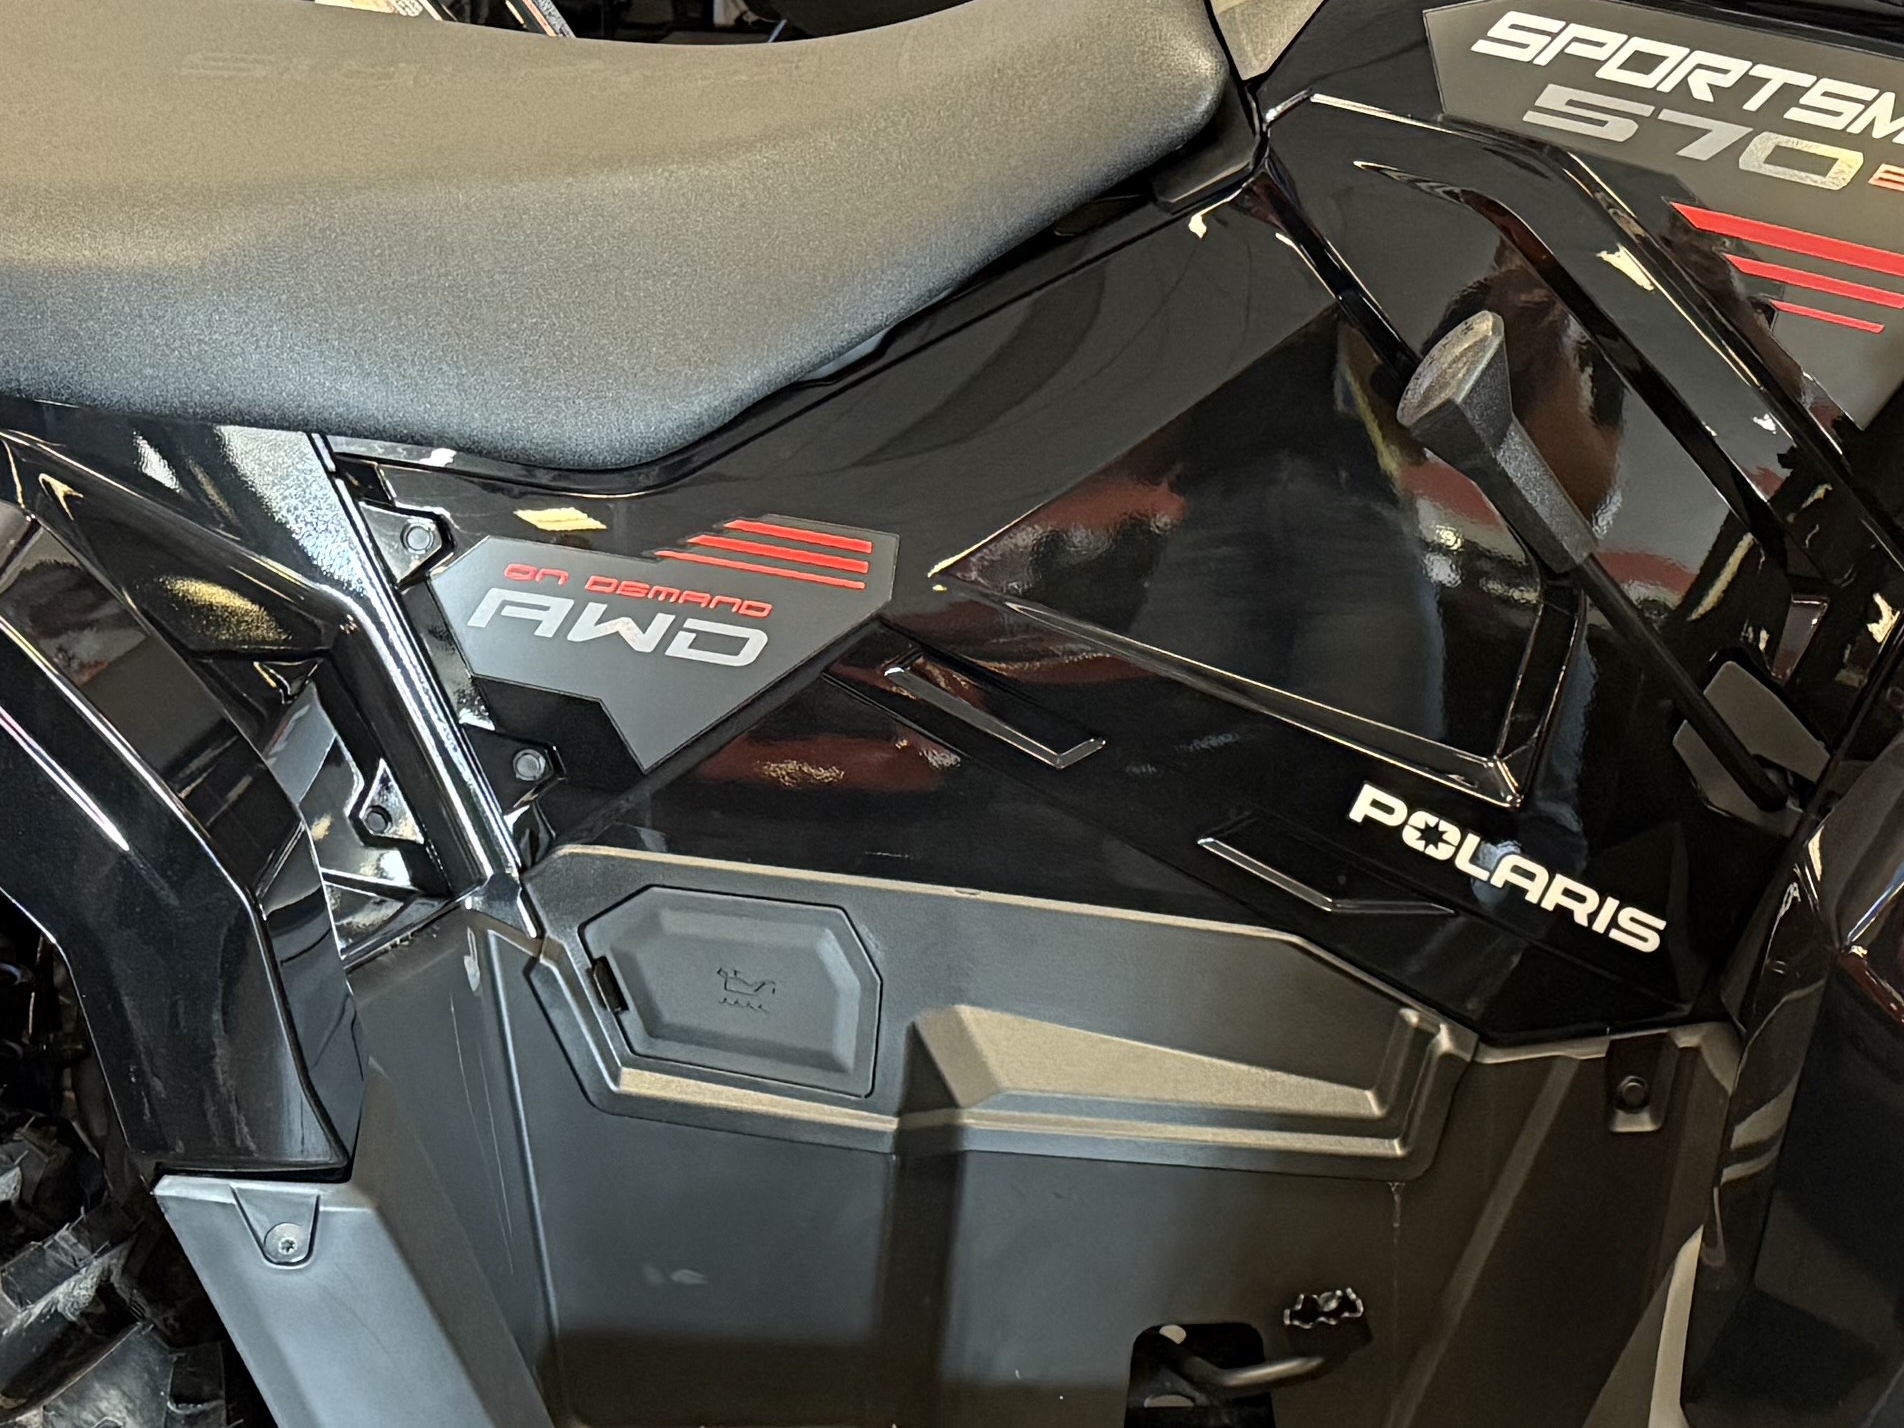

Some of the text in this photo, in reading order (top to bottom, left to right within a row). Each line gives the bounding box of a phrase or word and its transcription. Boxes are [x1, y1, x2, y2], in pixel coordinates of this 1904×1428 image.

[1522, 83, 1864, 191] 570
[468, 586, 769, 667] AWD
[505, 562, 773, 618] ON DEMAND
[1348, 780, 1667, 954] POLARIS
